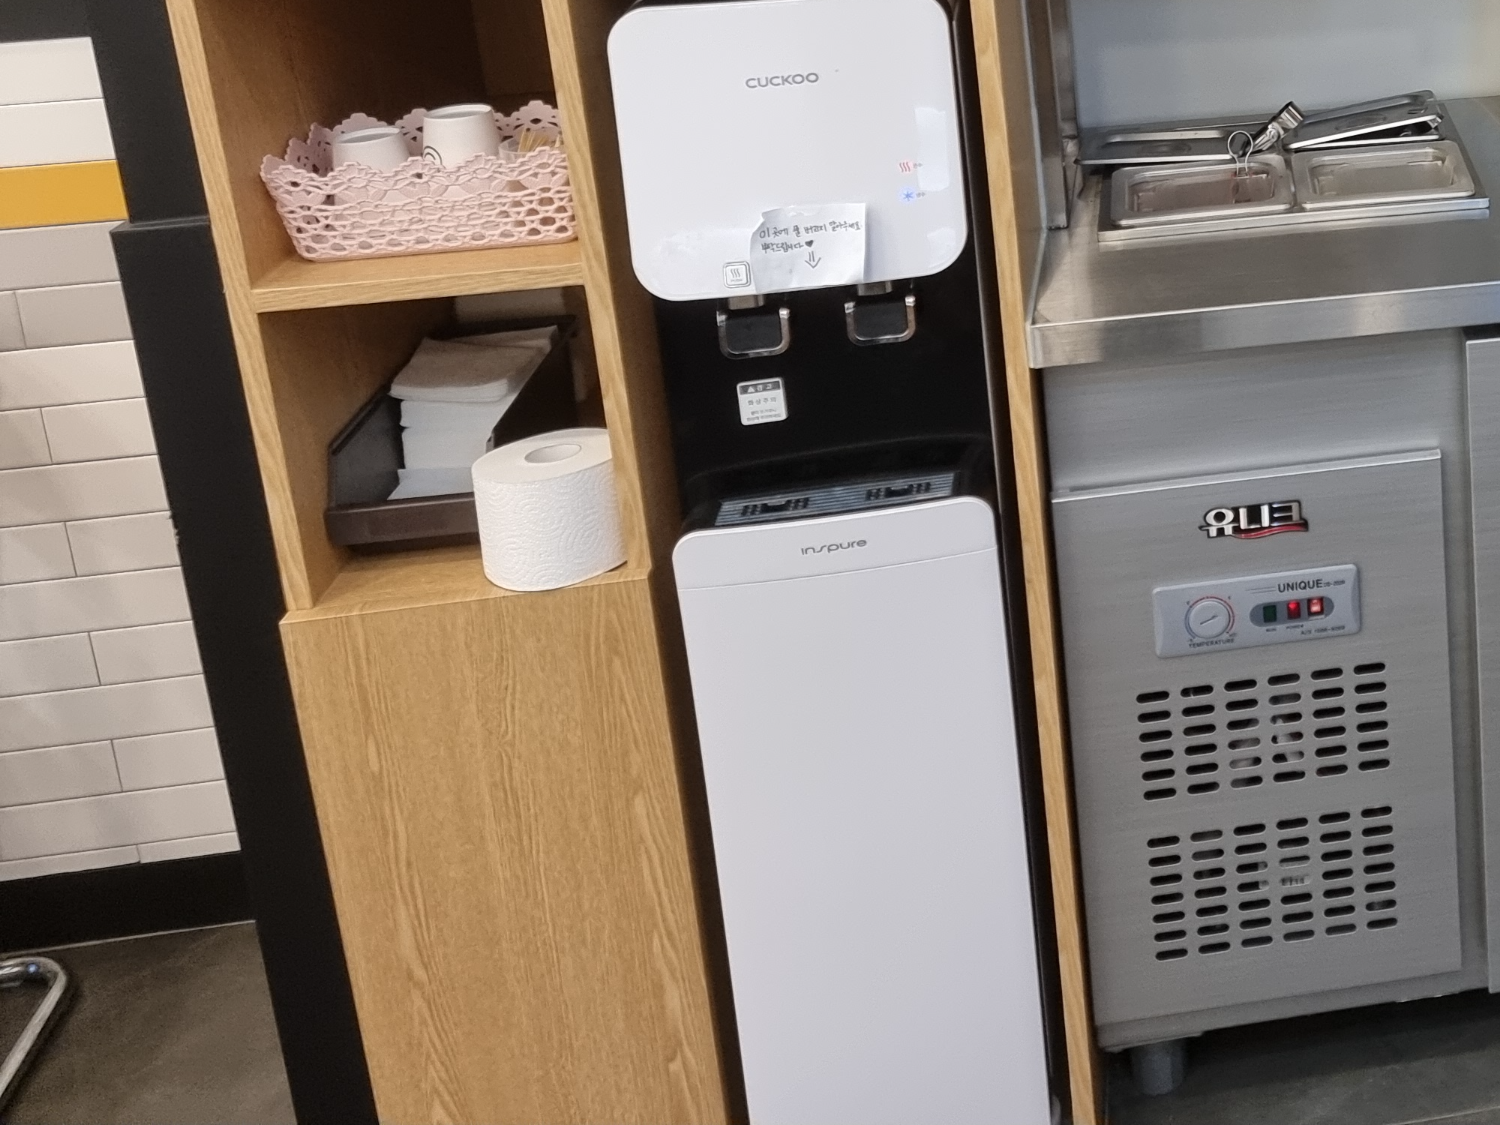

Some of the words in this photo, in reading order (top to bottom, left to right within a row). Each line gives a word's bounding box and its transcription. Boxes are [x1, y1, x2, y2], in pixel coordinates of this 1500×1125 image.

[745, 72, 819, 89] CUCKOO
[1277, 579, 1323, 593] UNIQUE
[1188, 637, 1235, 649] TEMPERATURE
